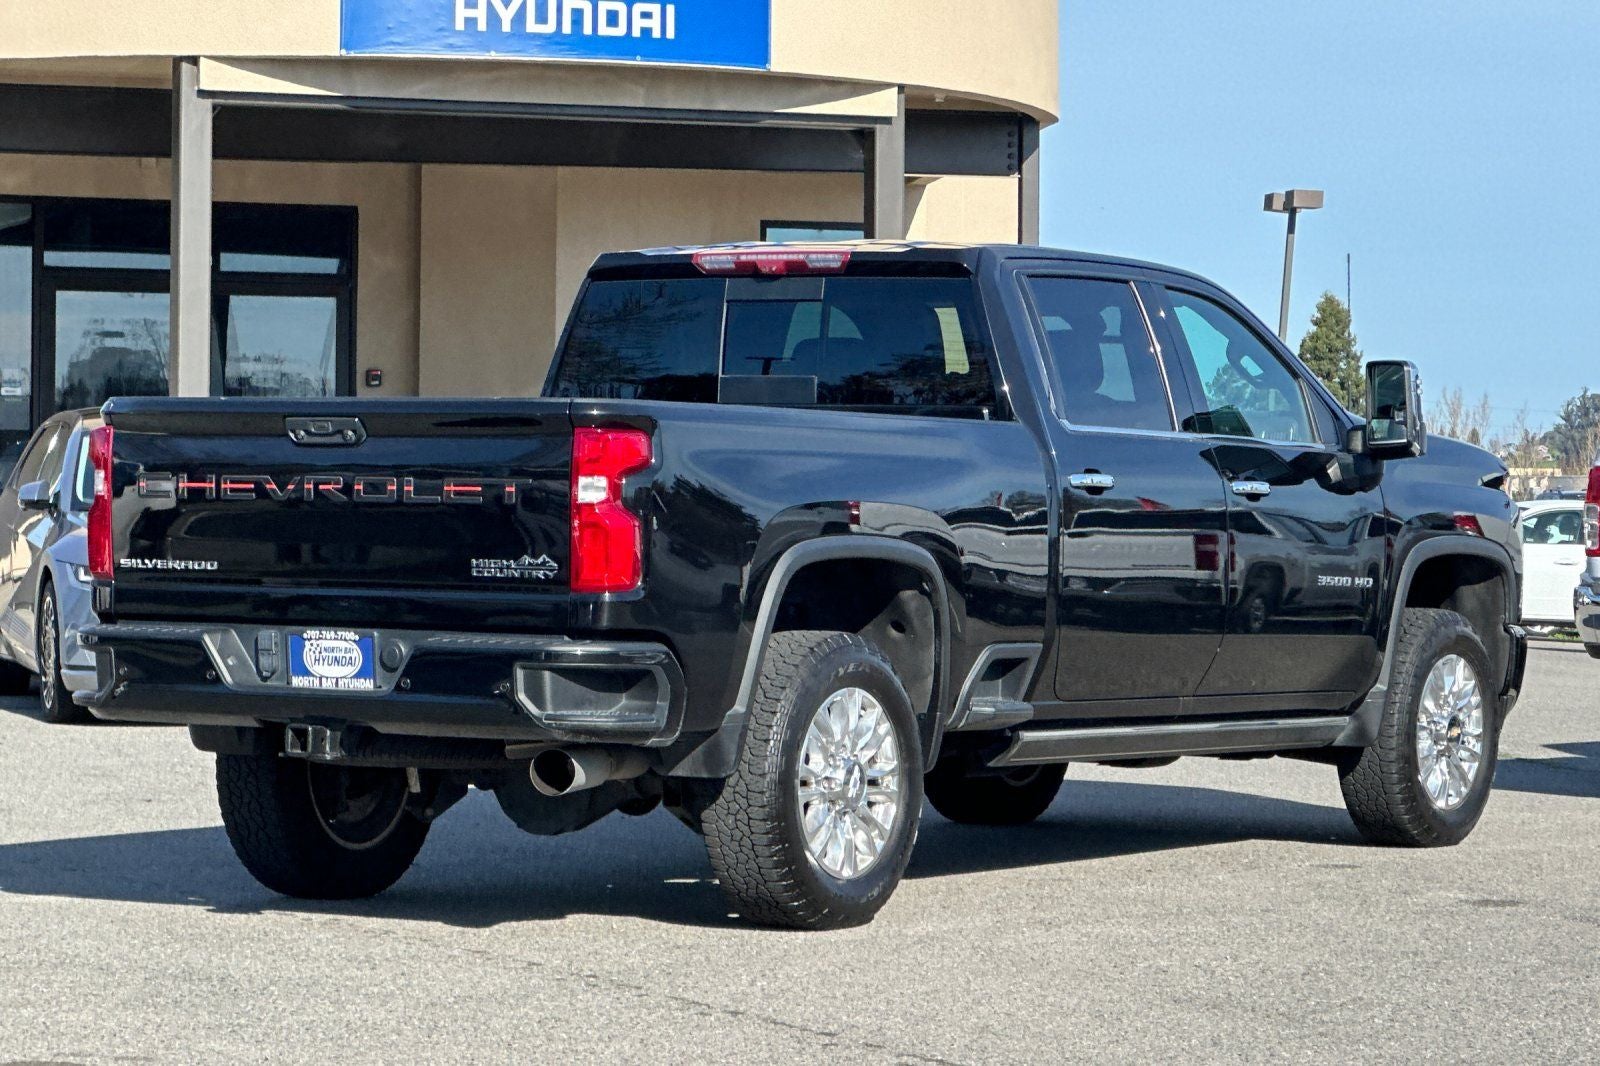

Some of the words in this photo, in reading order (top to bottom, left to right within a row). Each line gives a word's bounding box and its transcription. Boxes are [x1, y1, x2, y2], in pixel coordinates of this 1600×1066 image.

[455, 0, 675, 39] HYUNDAI
[138, 471, 532, 504] CHEVROLET
[120, 558, 218, 570] SILVERADO
[471, 558, 516, 568] HIGH
[471, 568, 558, 579] COUNTRY
[1318, 575, 1352, 587] 3500
[1354, 576, 1374, 588] HD
[323, 646, 342, 655] NORTH
[343, 646, 355, 655] BAY
[314, 655, 357, 668] HYUNDAI
[292, 676, 319, 688] NORTH
[321, 677, 336, 688] BAY
[337, 678, 374, 690] HYUNDAI
